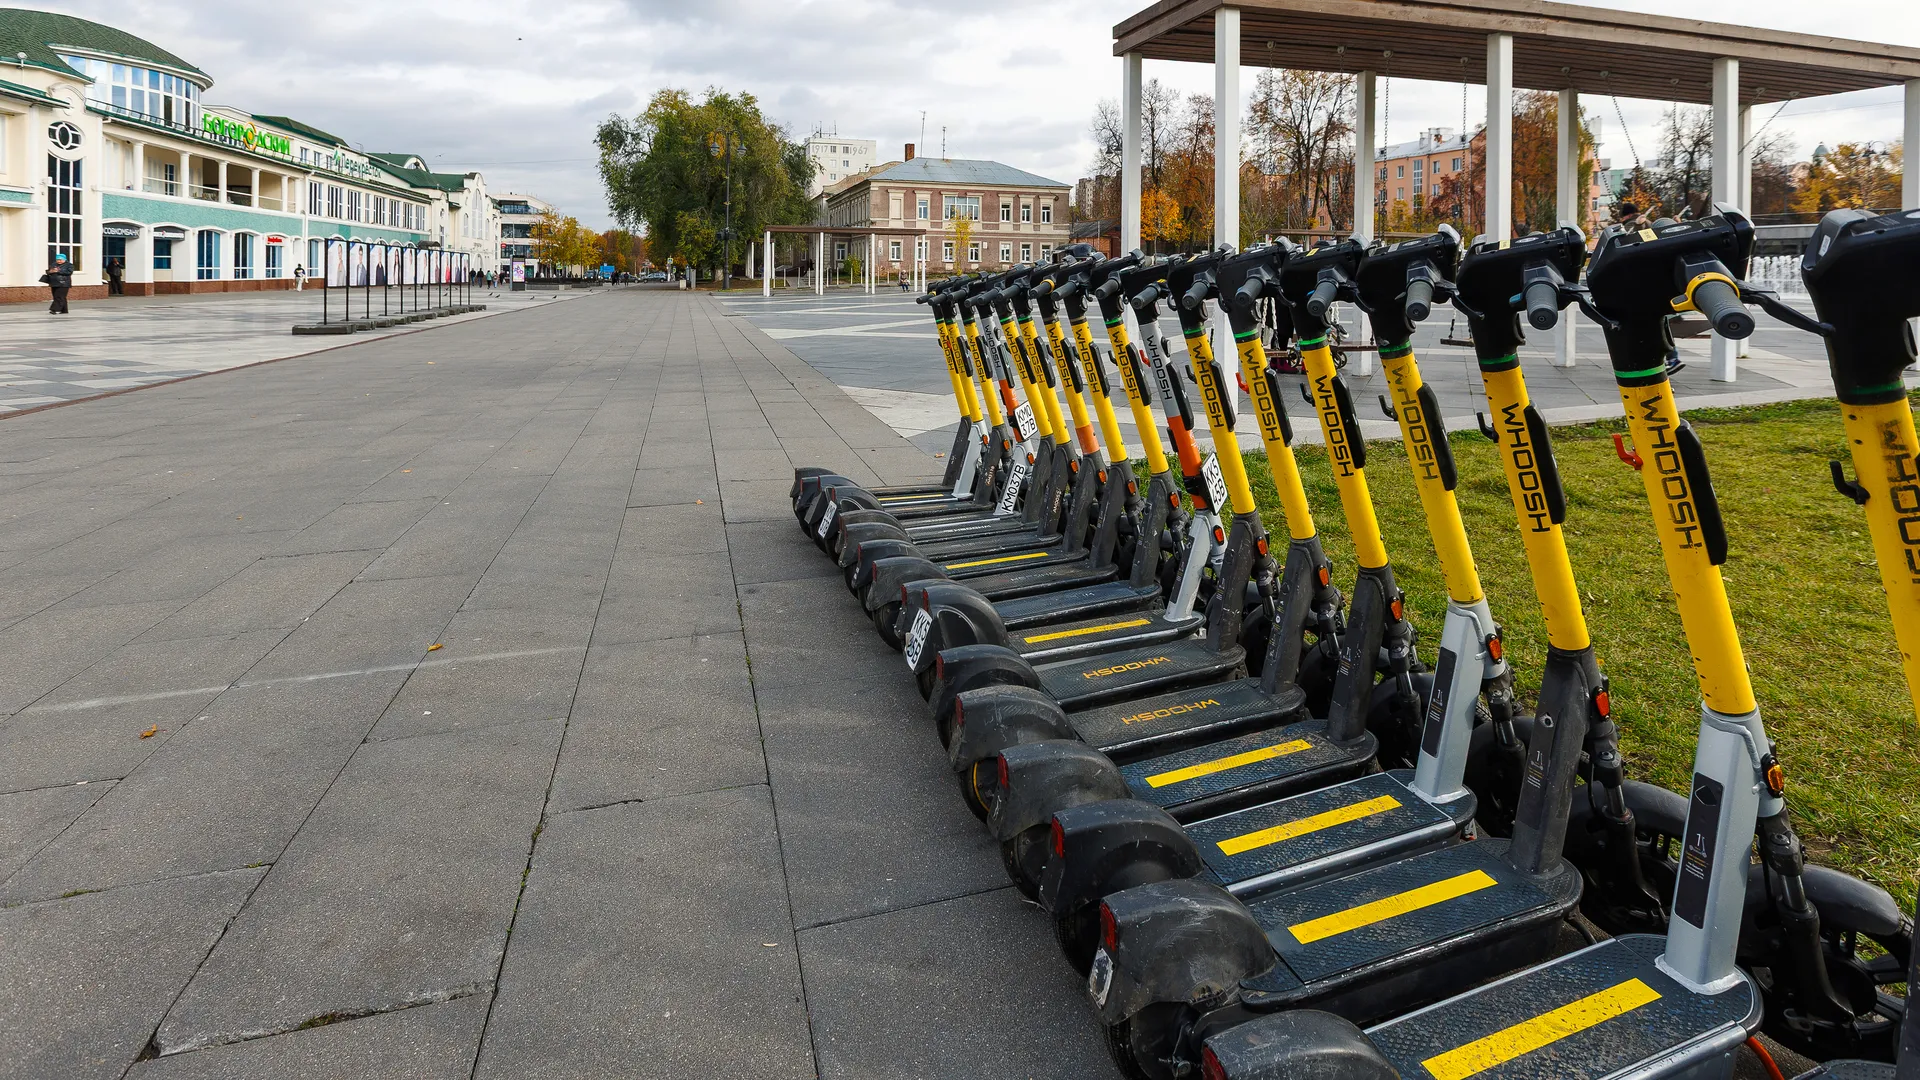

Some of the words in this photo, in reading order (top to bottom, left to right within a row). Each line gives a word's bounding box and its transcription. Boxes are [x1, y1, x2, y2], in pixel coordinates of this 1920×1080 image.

[202, 113, 290, 155] БОГОРОДСКИЙ
[849, 146, 868, 156] 1967
[939, 326, 954, 371] WHOOSH
[948, 326, 966, 374] WHOOSH
[969, 335, 986, 383] WHOOSH
[984, 325, 1001, 369] WHOOSH
[1005, 327, 1027, 380] WHOOSH
[1022, 326, 1046, 384] WHOOSH
[1048, 328, 1073, 388] WHOOSH
[1075, 328, 1100, 394] WHOOSH
[1112, 330, 1140, 400] WHOOSH
[1146, 335, 1173, 400] WHOOSH
[1192, 341, 1224, 428] WHOOSH
[1243, 348, 1280, 442] WHOOSH
[1315, 375, 1354, 477] WHOOSH
[1391, 364, 1438, 480] WHOOSH
[1501, 402, 1550, 533] WHOOSH
[1640, 394, 1702, 549] WHOOSH
[1877, 419, 1920, 584] WHOOS
[1083, 656, 1171, 679] WHOOSH
[1121, 698, 1221, 725] WHOOSH
